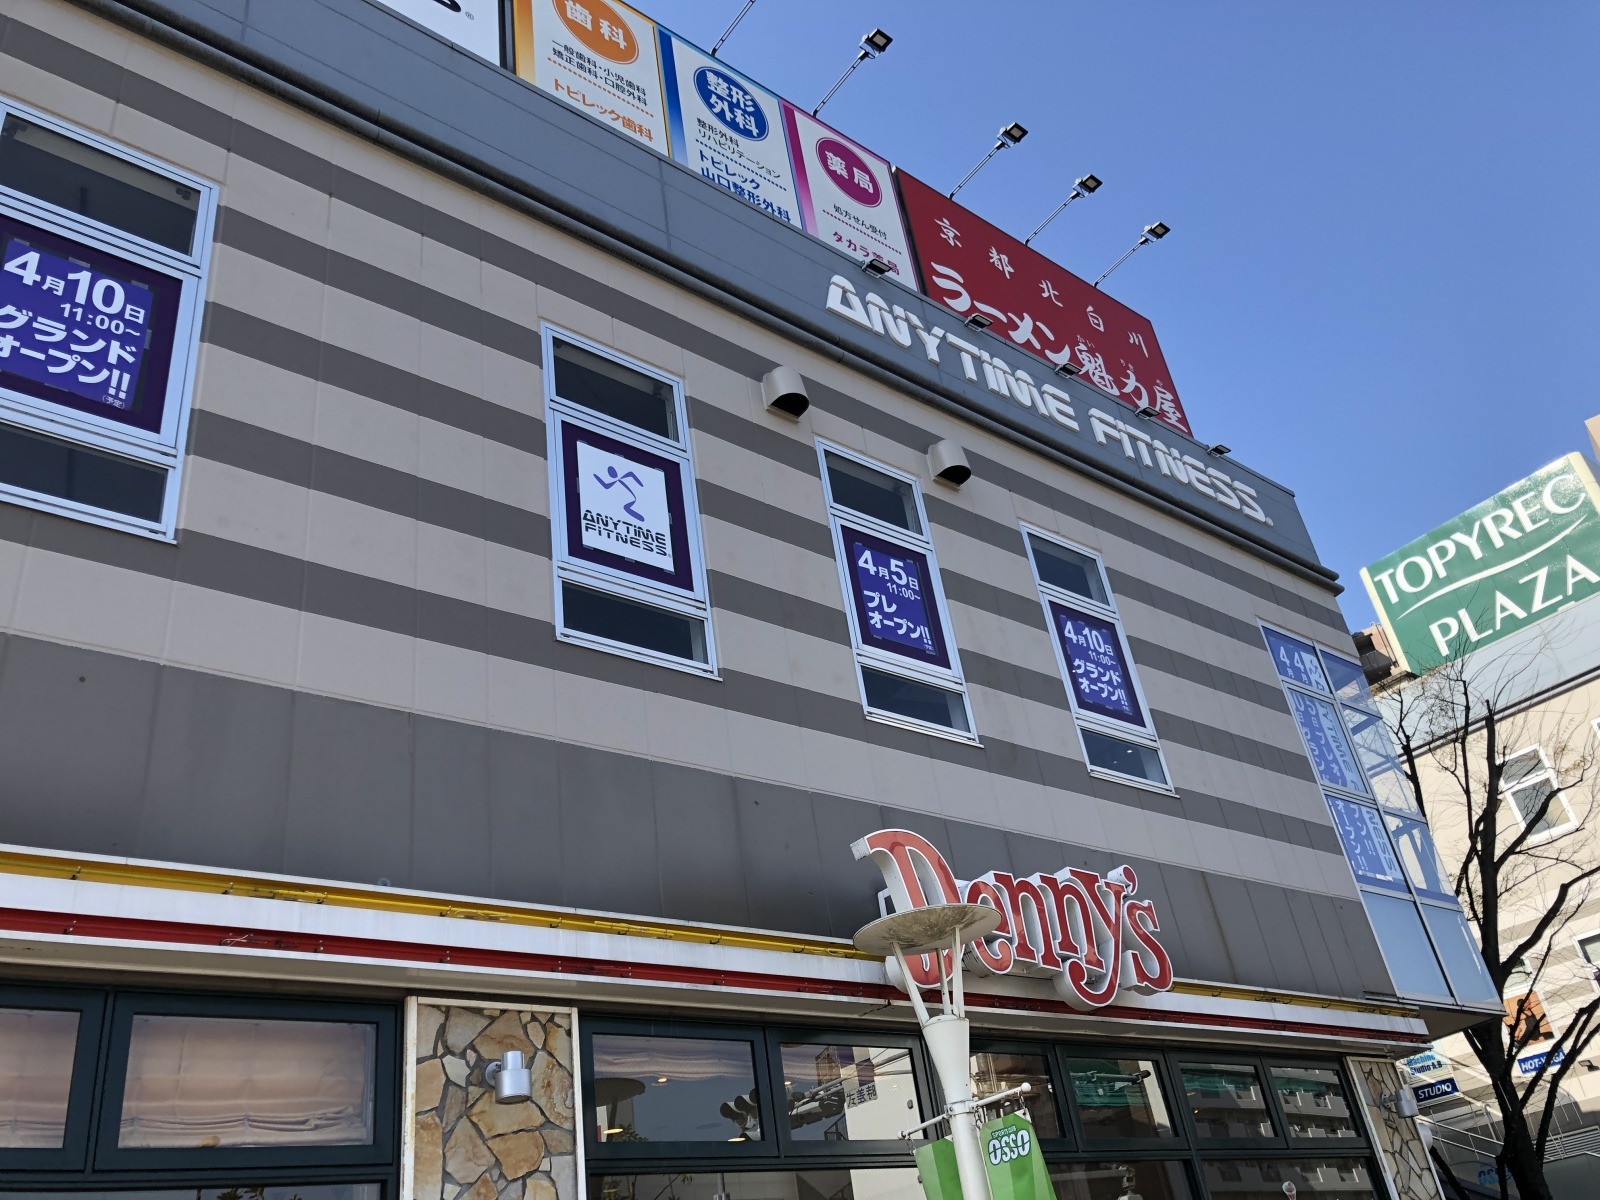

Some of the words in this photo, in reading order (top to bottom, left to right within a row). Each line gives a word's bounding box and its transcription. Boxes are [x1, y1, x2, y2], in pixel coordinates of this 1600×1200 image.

[565, 0, 627, 49] 歯科
[554, 78, 653, 142] トピレック歯科
[705, 70, 755, 112] 整形
[696, 117, 740, 149] 整形外科
[709, 93, 759, 138] 外科
[698, 128, 781, 179] リハビリテーション
[699, 149, 761, 190] トピレック
[825, 150, 874, 194] 薬局
[700, 167, 791, 223] 山口整形外科
[833, 203, 887, 240] 処方せん受付
[3, 250, 145, 325] 4月10日
[0, 304, 137, 365] グランド
[825, 274, 1080, 433] ANYTIME
[1087, 407, 1266, 525] FITNESS
[582, 508, 667, 546] ANYTIME
[584, 522, 667, 557] FITNESS
[1373, 474, 1586, 605] TOPYREC
[858, 549, 919, 591] 4月5日
[863, 590, 897, 613] プレ
[1428, 554, 1600, 657] PLAZA
[1064, 621, 1114, 657] 4月10日
[1073, 658, 1122, 686] グランド
[853, 829, 1174, 1008] Denny's
[1521, 1052, 1565, 1071] HOT-YGA
[1418, 1082, 1452, 1099] STUDIO
[989, 1130, 1030, 1165] OSSO
